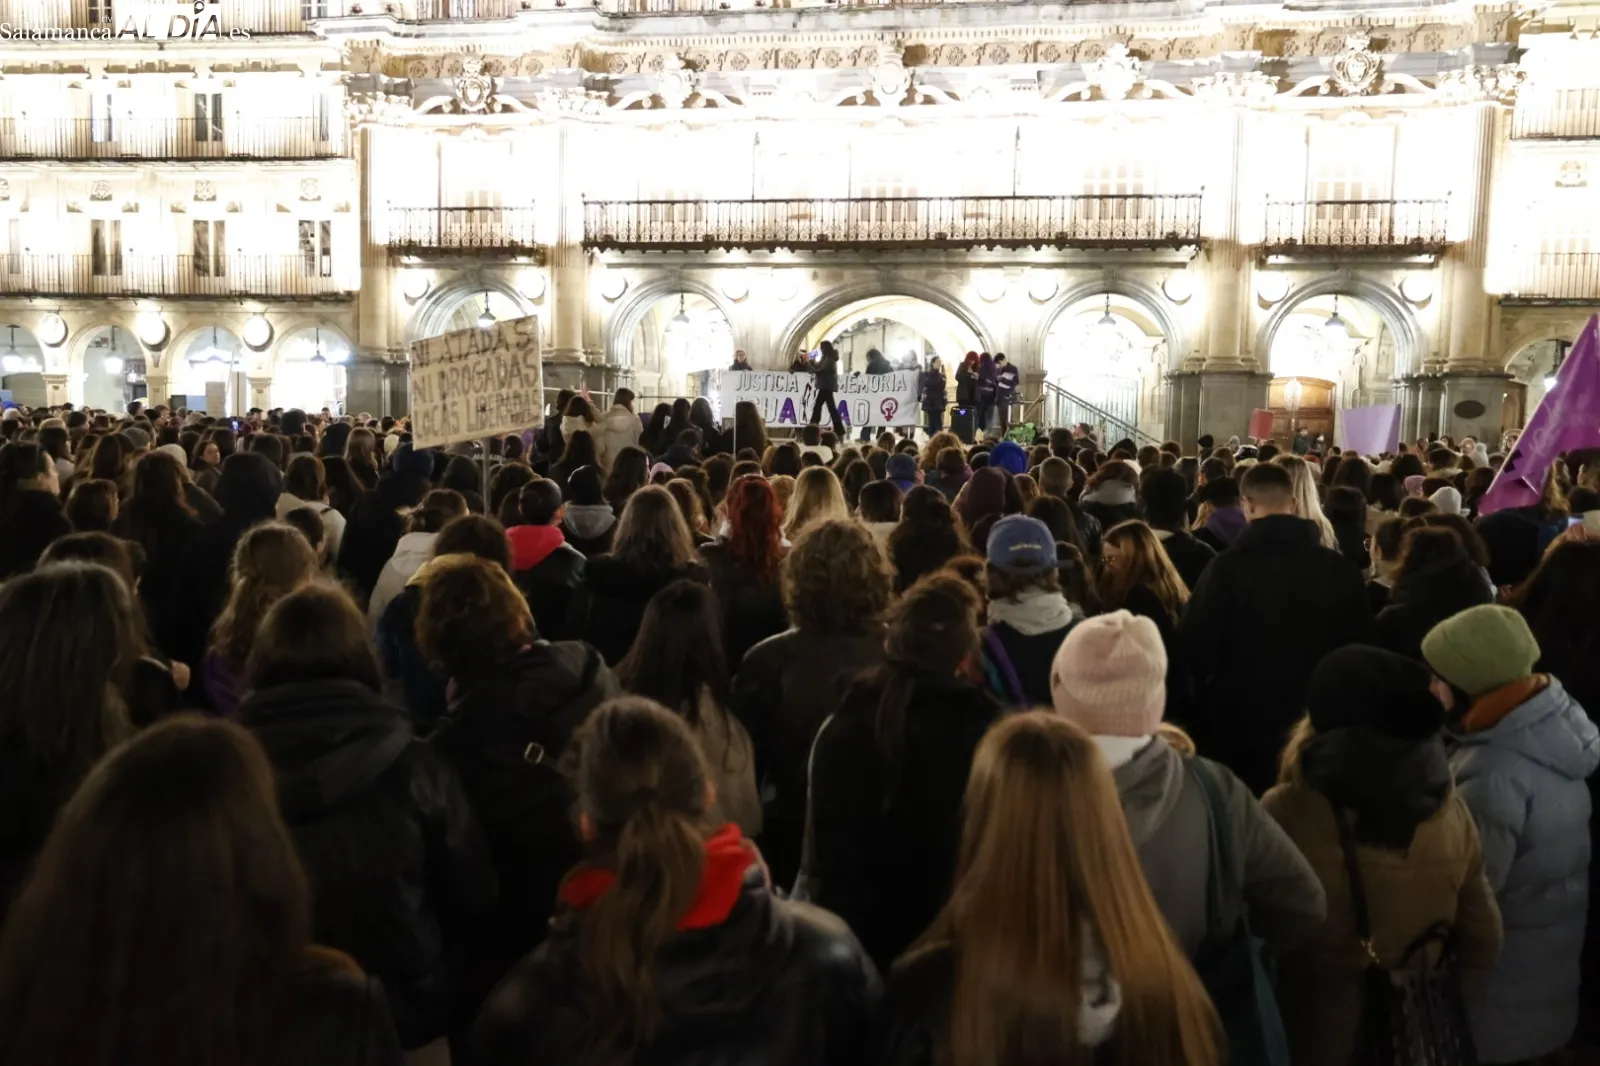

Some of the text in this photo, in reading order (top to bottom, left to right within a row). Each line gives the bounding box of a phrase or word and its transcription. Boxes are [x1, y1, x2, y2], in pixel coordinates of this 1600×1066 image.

[413, 373, 434, 404] NI
[734, 372, 907, 393] JUSTICIA MEMORIA
